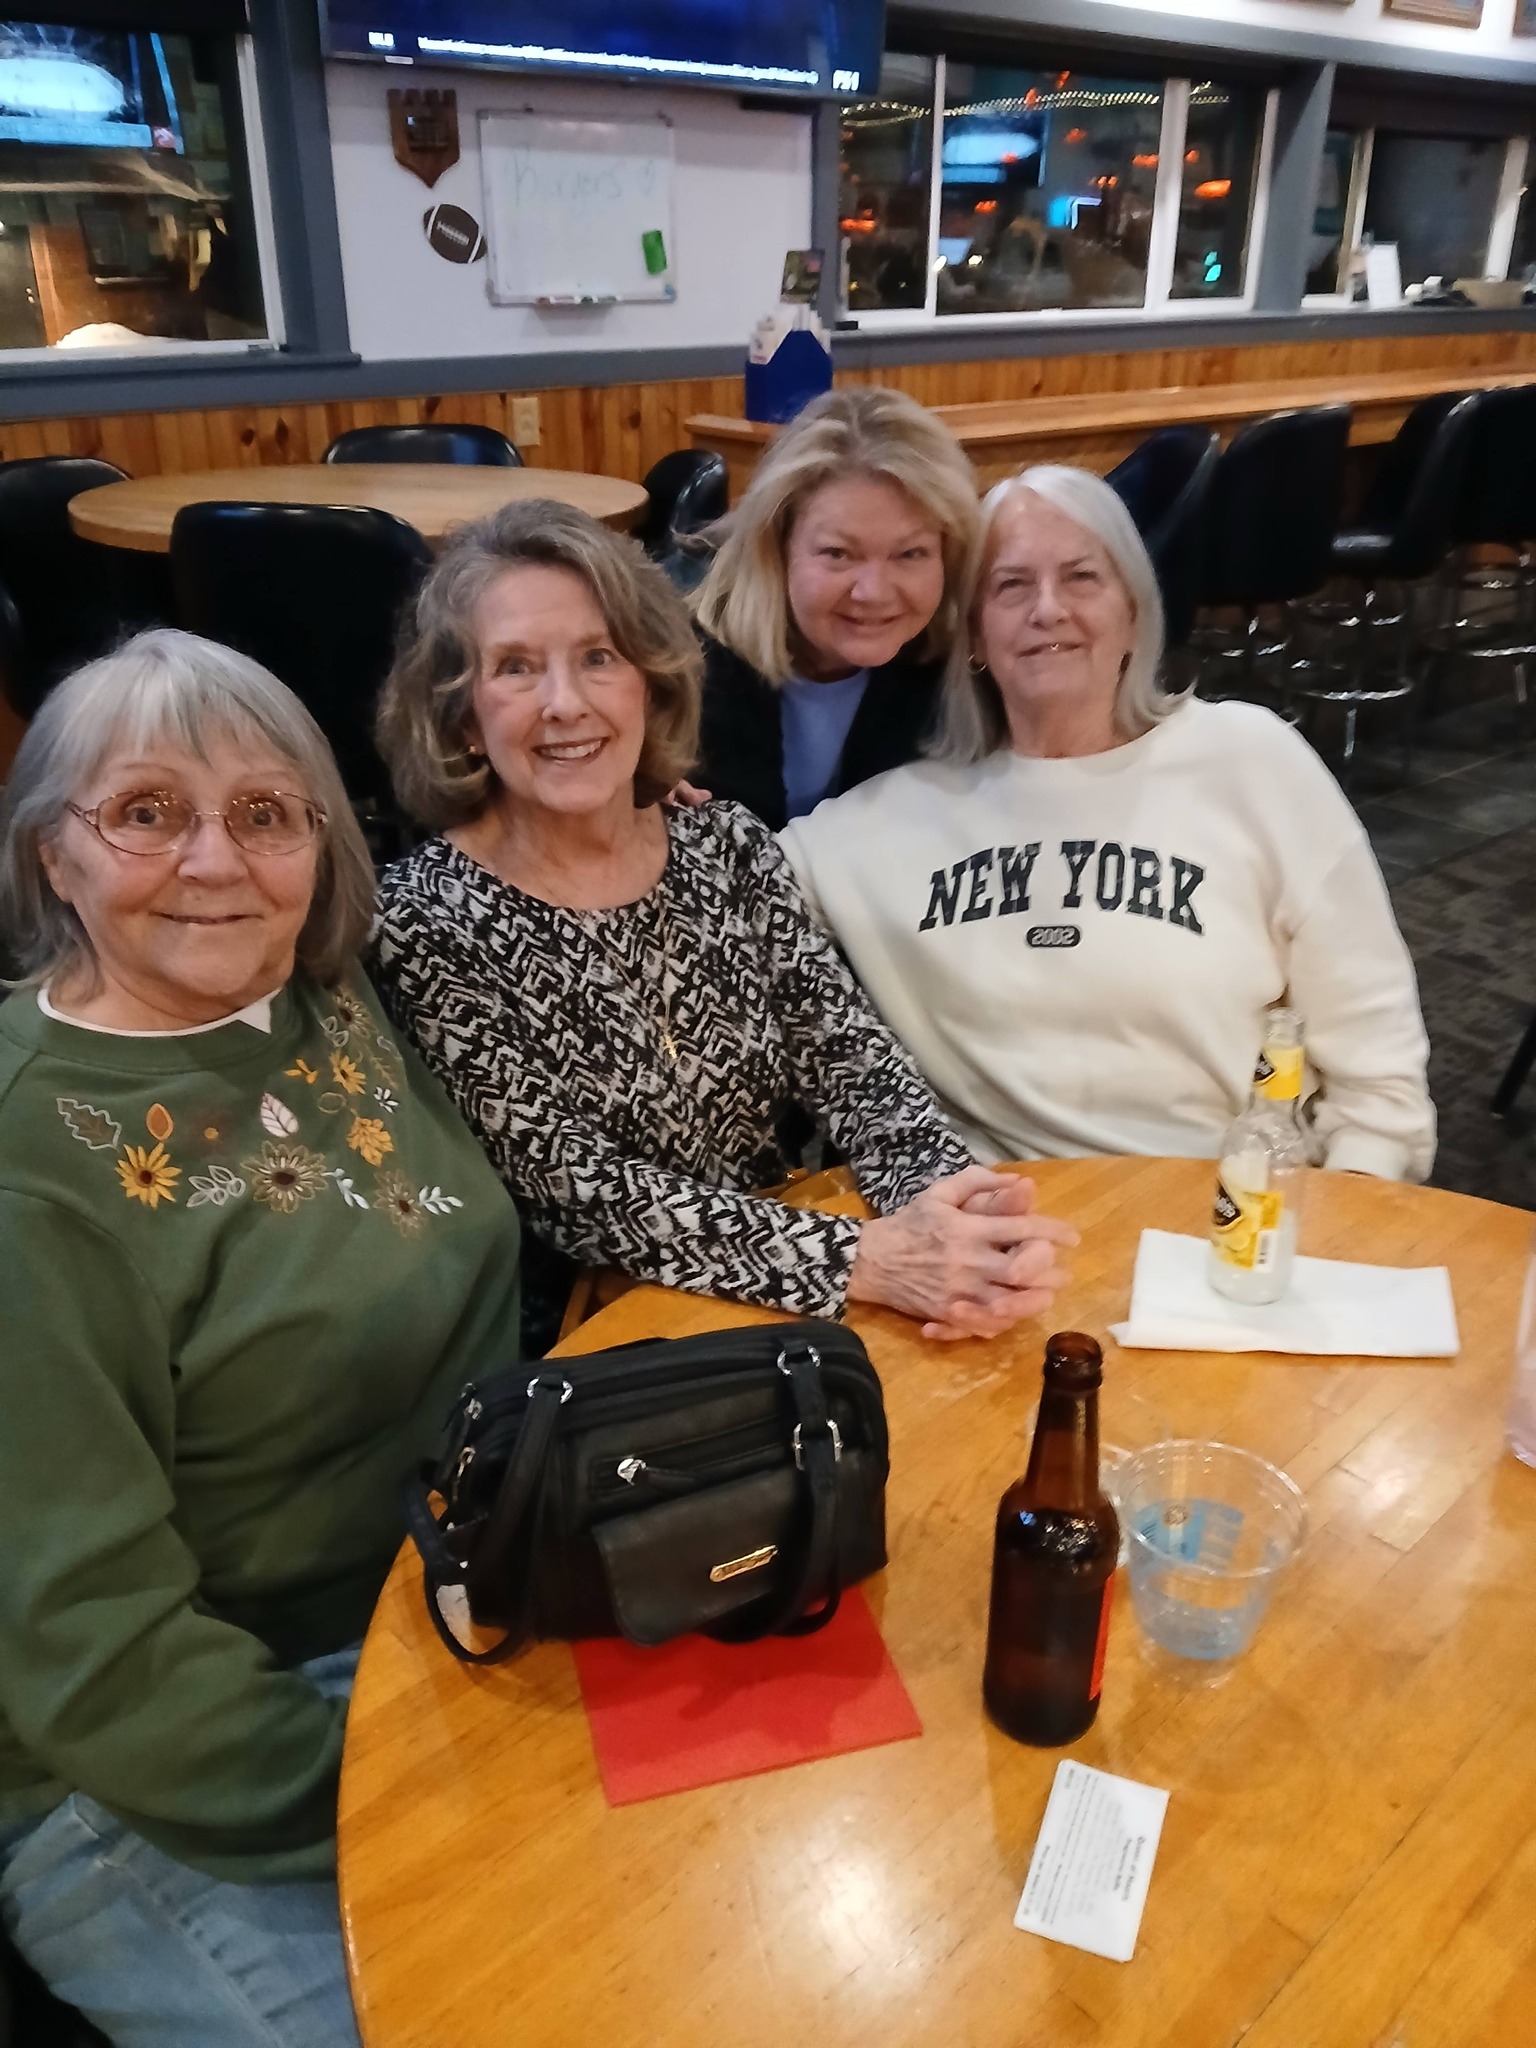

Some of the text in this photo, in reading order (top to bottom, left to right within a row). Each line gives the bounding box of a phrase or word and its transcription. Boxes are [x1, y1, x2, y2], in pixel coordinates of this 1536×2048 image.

[918, 839, 1206, 934] NEW YORK
[1031, 926, 1077, 946] 2002
